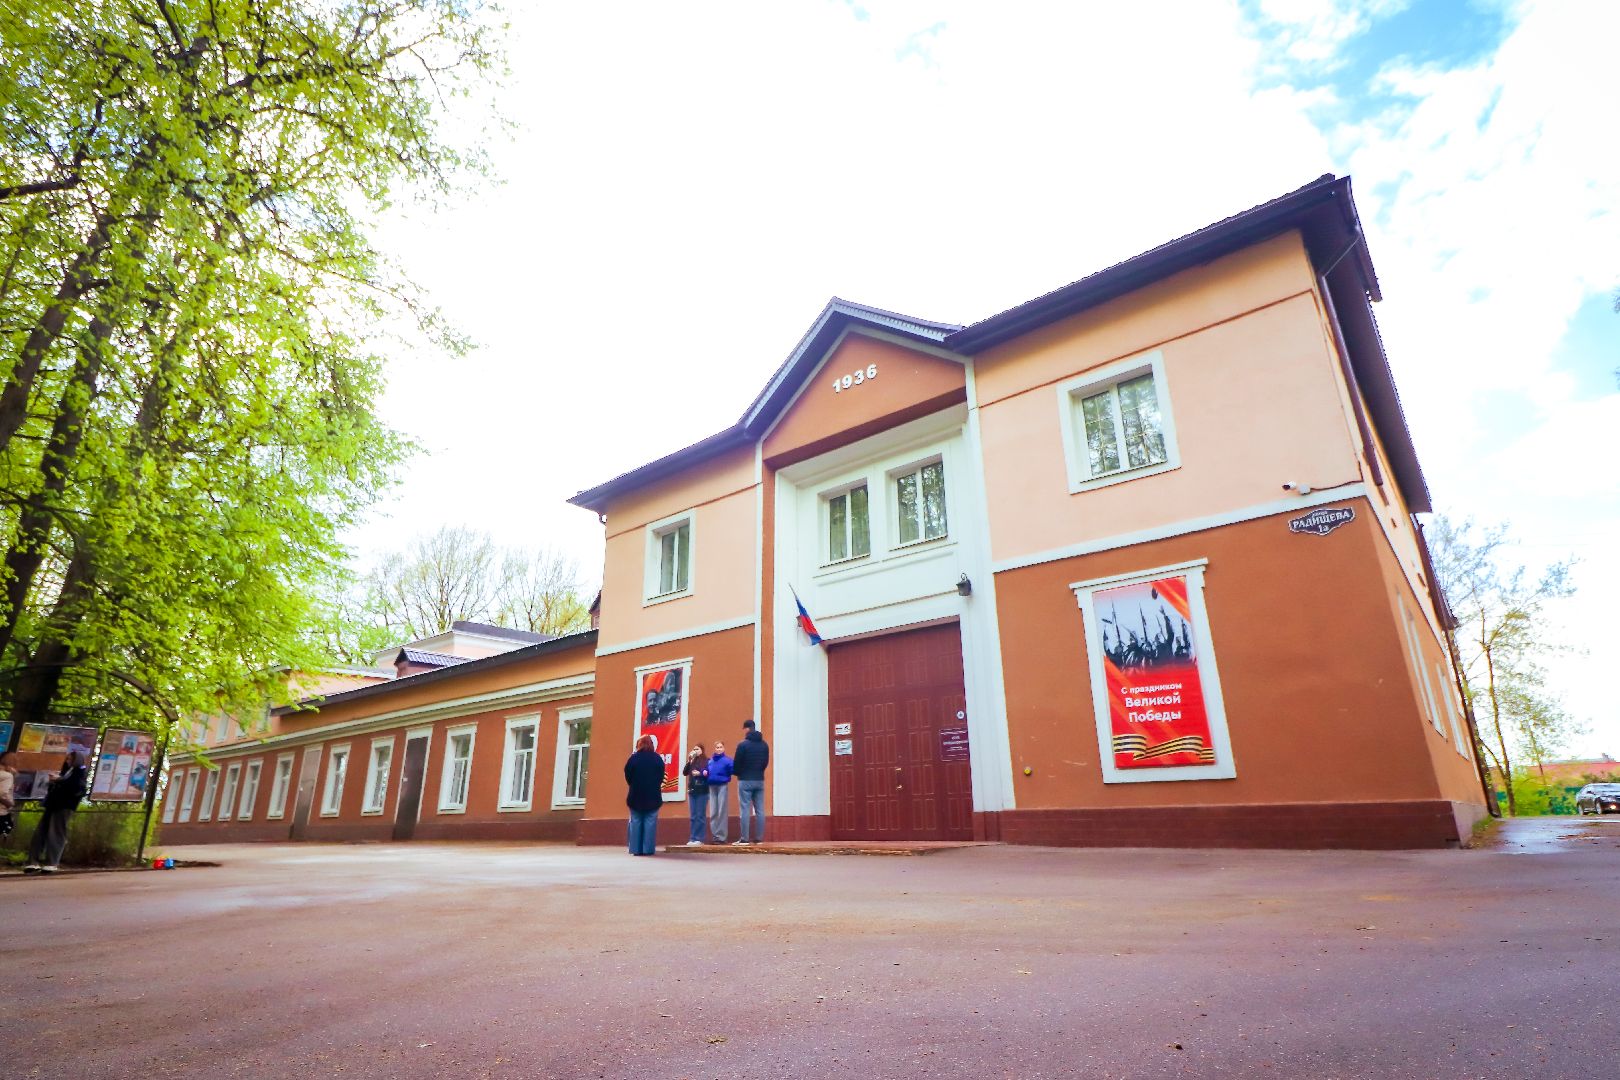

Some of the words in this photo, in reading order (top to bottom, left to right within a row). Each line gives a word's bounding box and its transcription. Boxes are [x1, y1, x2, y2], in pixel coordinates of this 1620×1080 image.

[832, 363, 878, 393] 1936
[1292, 511, 1351, 529] РАДИЩЕВА
[1120, 686, 1128, 694] С
[1129, 683, 1182, 694] праздником
[1125, 692, 1181, 708] Великой
[1128, 709, 1182, 723] Победы
